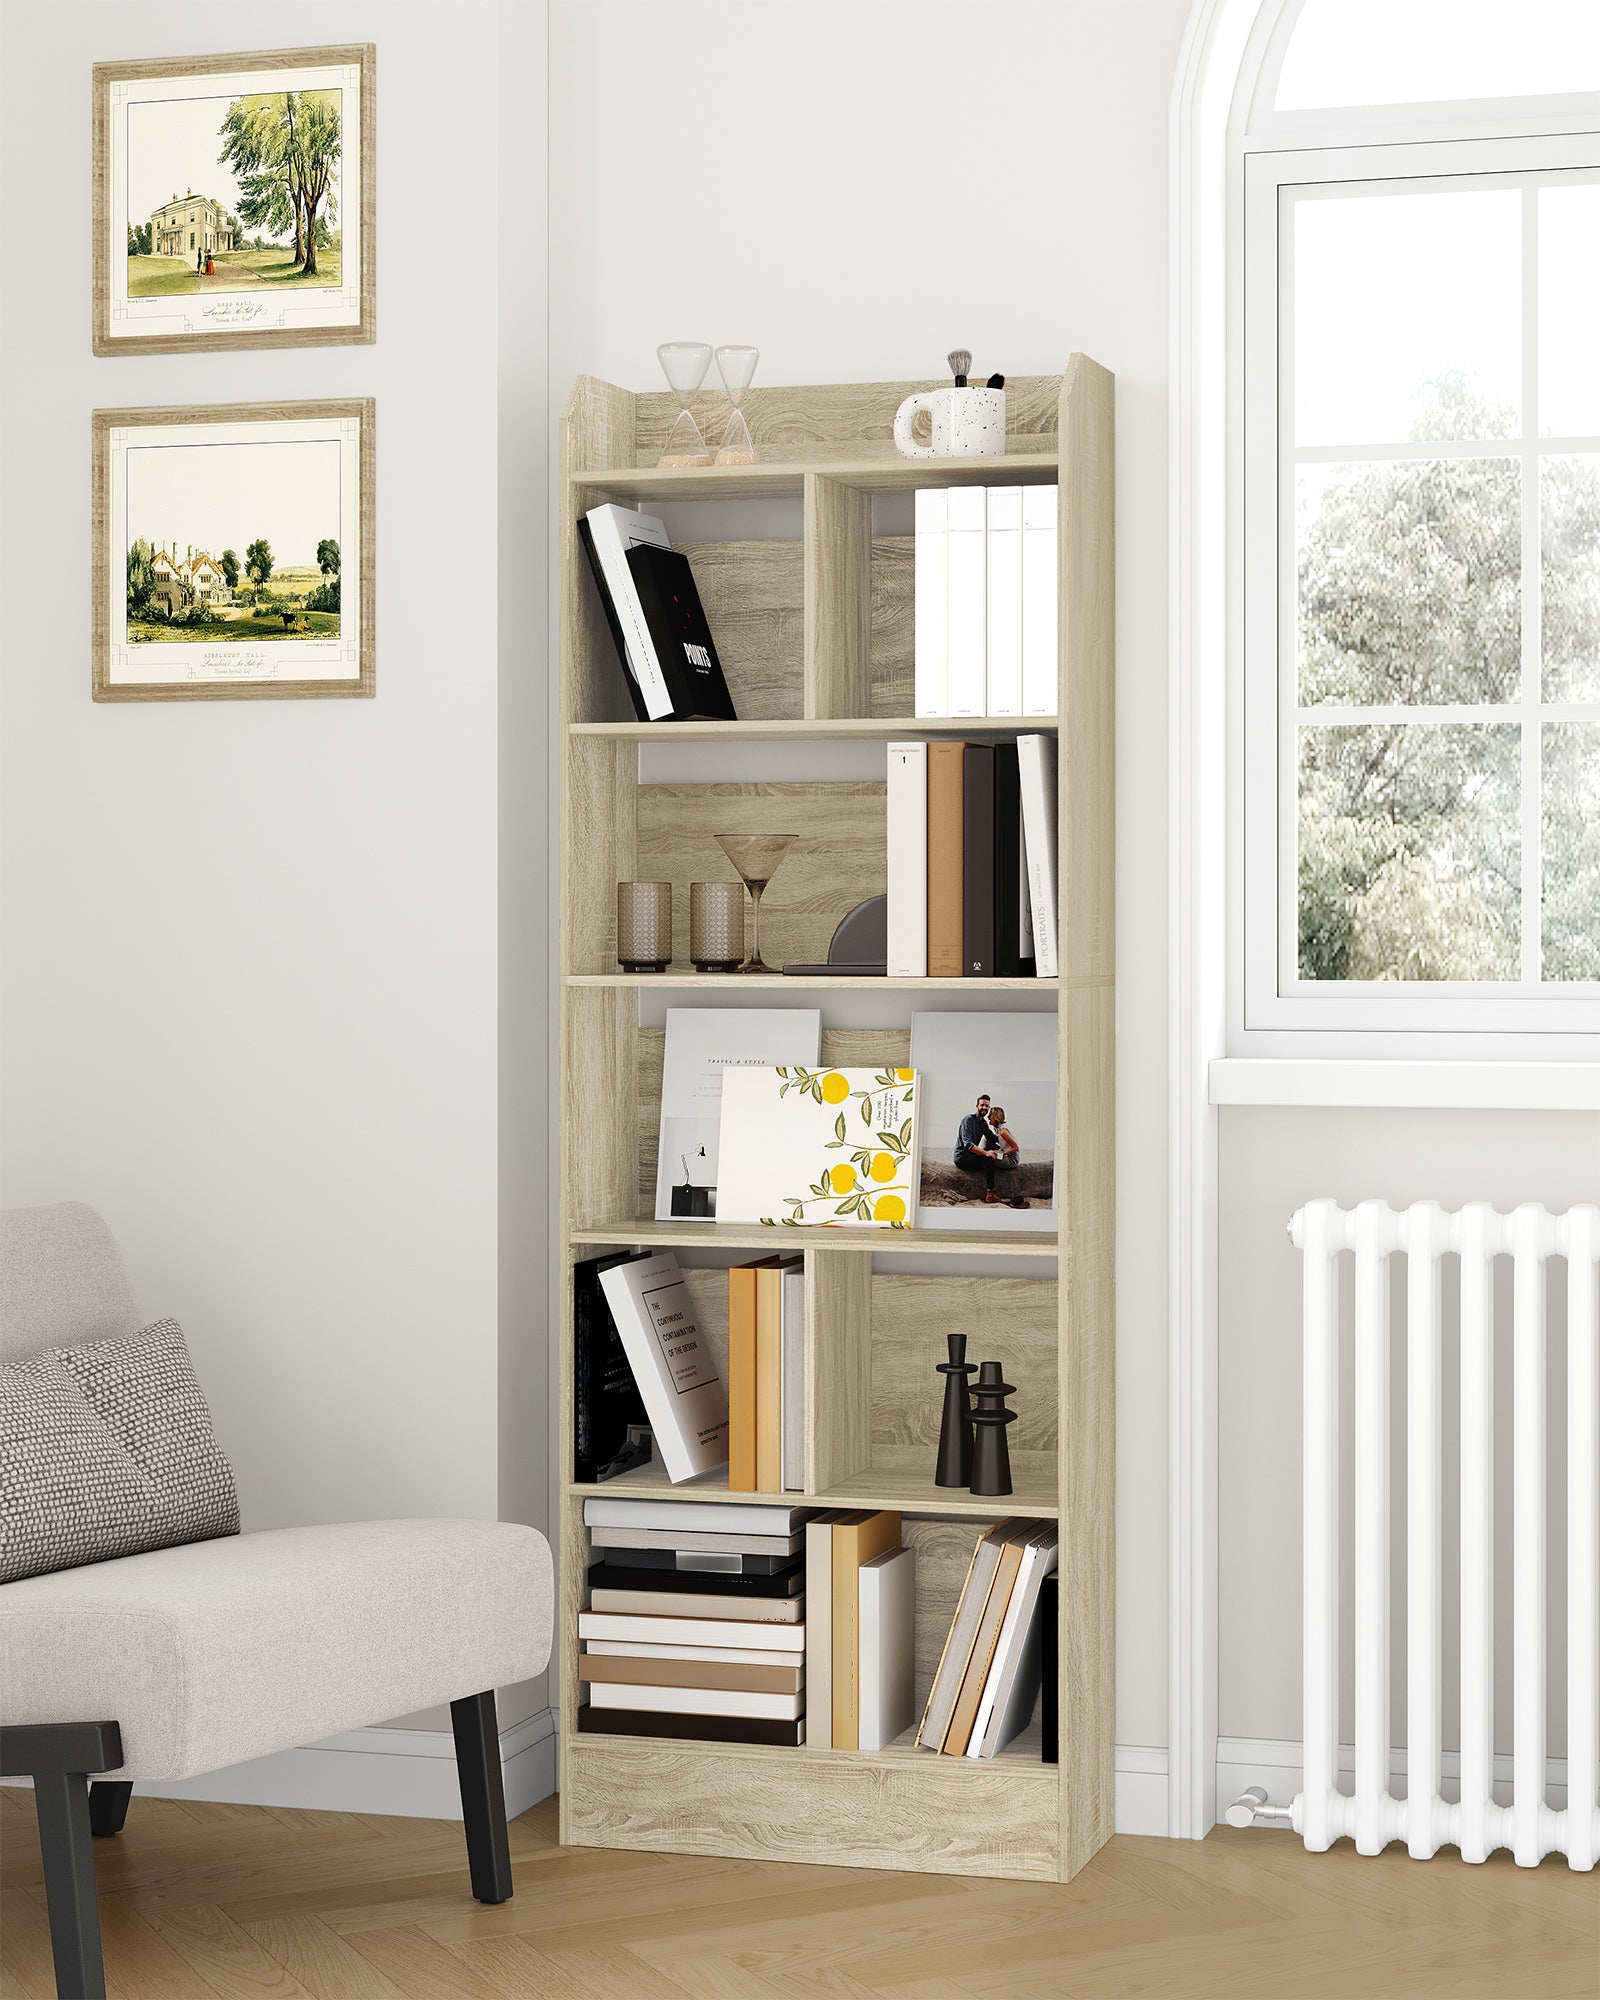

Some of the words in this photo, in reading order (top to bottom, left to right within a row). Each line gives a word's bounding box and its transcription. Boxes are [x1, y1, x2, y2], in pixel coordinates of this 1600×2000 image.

[683, 642, 711, 668] POINTS
[902, 756, 906, 764] 1
[1038, 906, 1048, 957] PORTRAITS
[651, 1302, 661, 1312] THE
[657, 1312, 684, 1327] CONTINUOUS
[662, 1325, 696, 1342] CONTAMINATION
[668, 1348, 675, 1358] OF
[674, 1344, 683, 1356] THE
[682, 1341, 698, 1353] DESIGN
